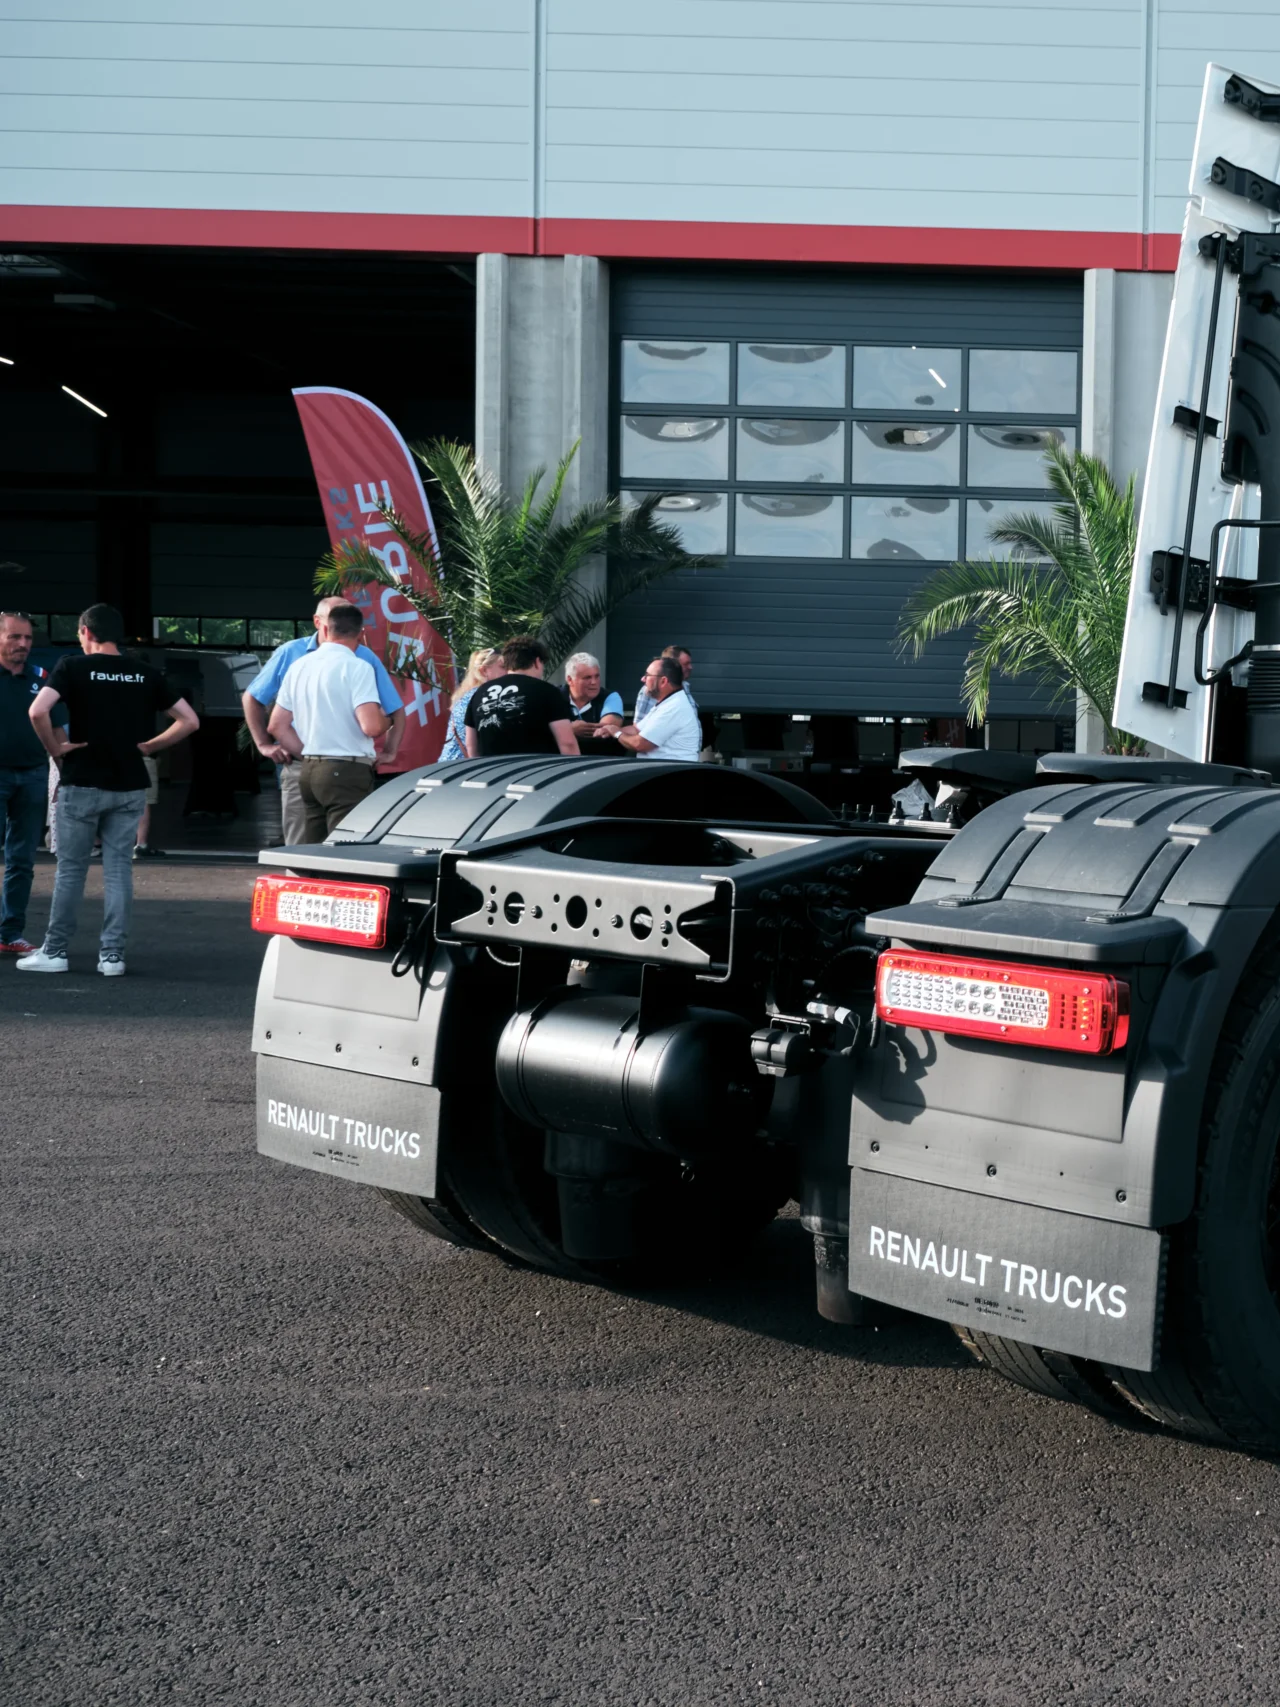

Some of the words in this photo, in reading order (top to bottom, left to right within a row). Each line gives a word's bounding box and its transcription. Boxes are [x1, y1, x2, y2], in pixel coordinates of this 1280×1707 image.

[90, 670, 145, 683] faurie.fr
[267, 1099, 340, 1141] RENAULT
[343, 1117, 421, 1159] TRUCKS
[869, 1225, 993, 1287] RENAULT
[999, 1258, 1128, 1319] TRUCKS
